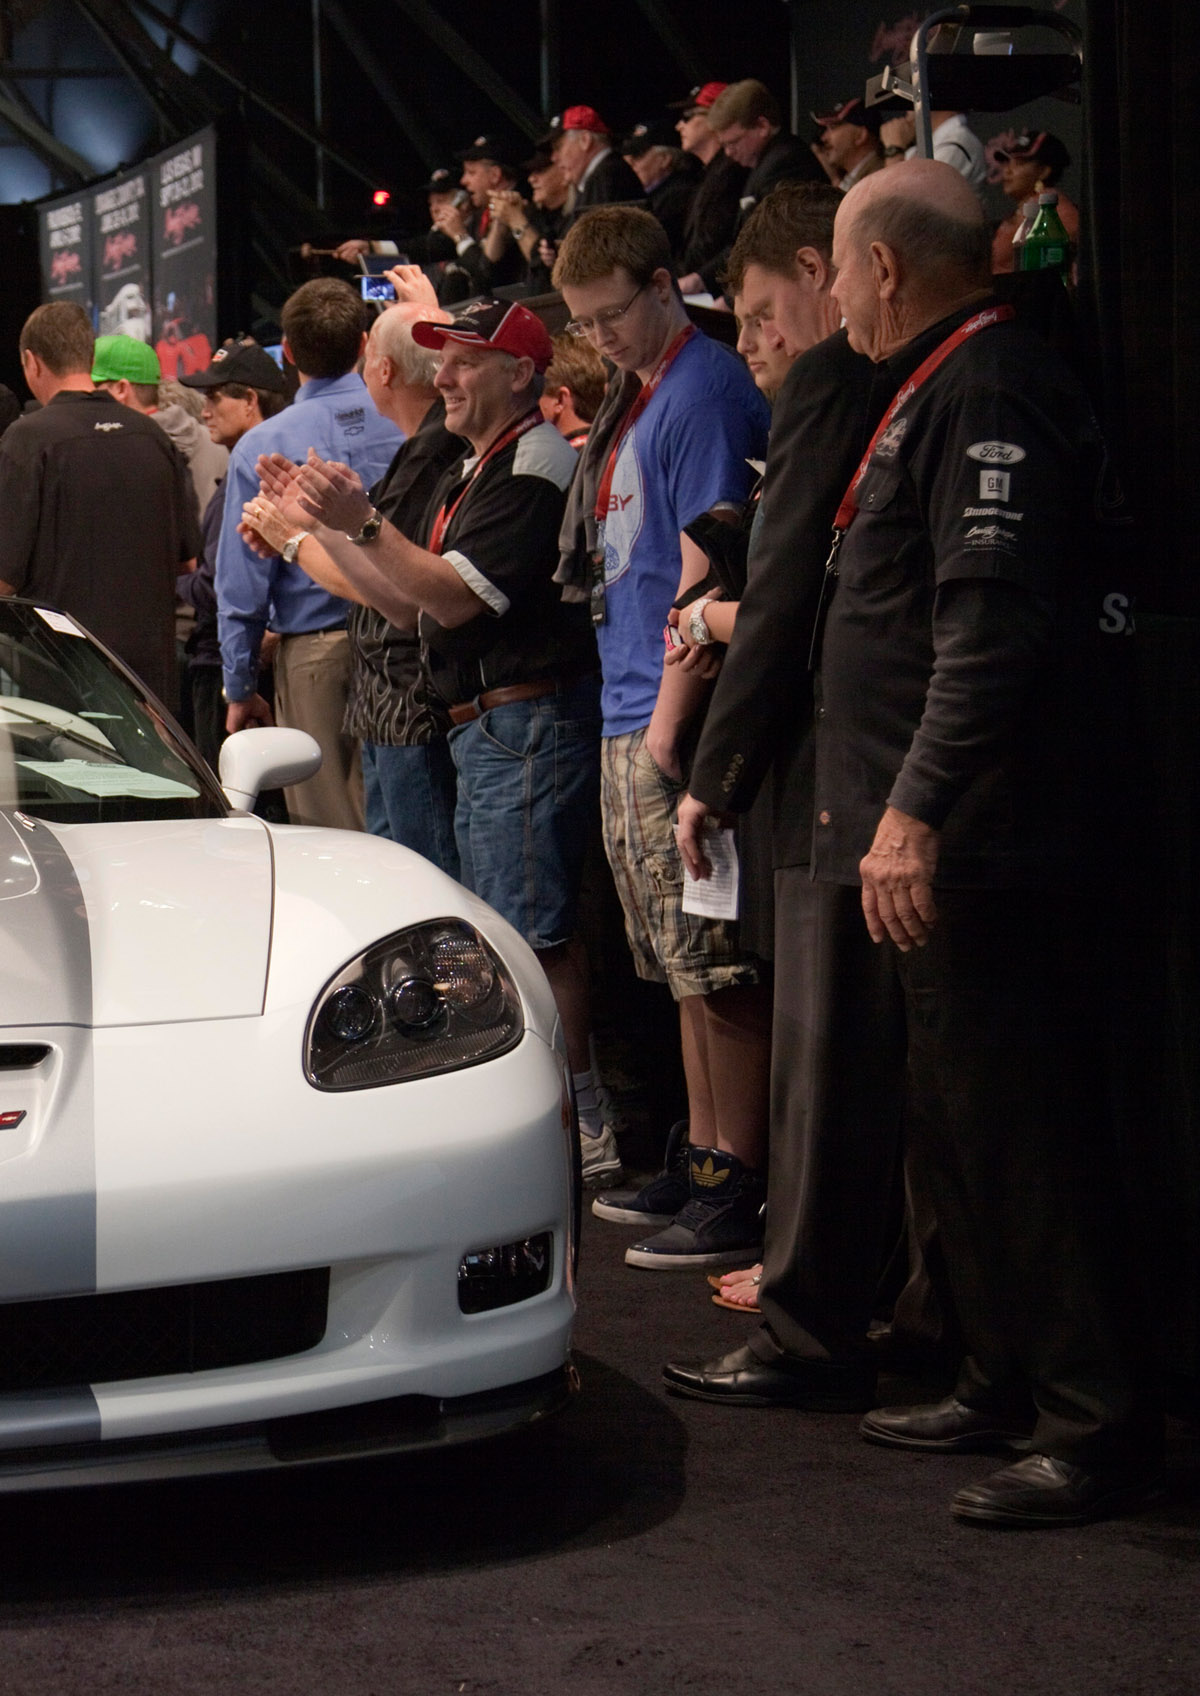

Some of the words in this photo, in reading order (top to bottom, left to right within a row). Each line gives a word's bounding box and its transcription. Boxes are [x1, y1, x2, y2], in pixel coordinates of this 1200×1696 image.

[979, 444, 1014, 461] Ford
[987, 477, 1004, 490] GM
[1099, 592, 1136, 636] S
